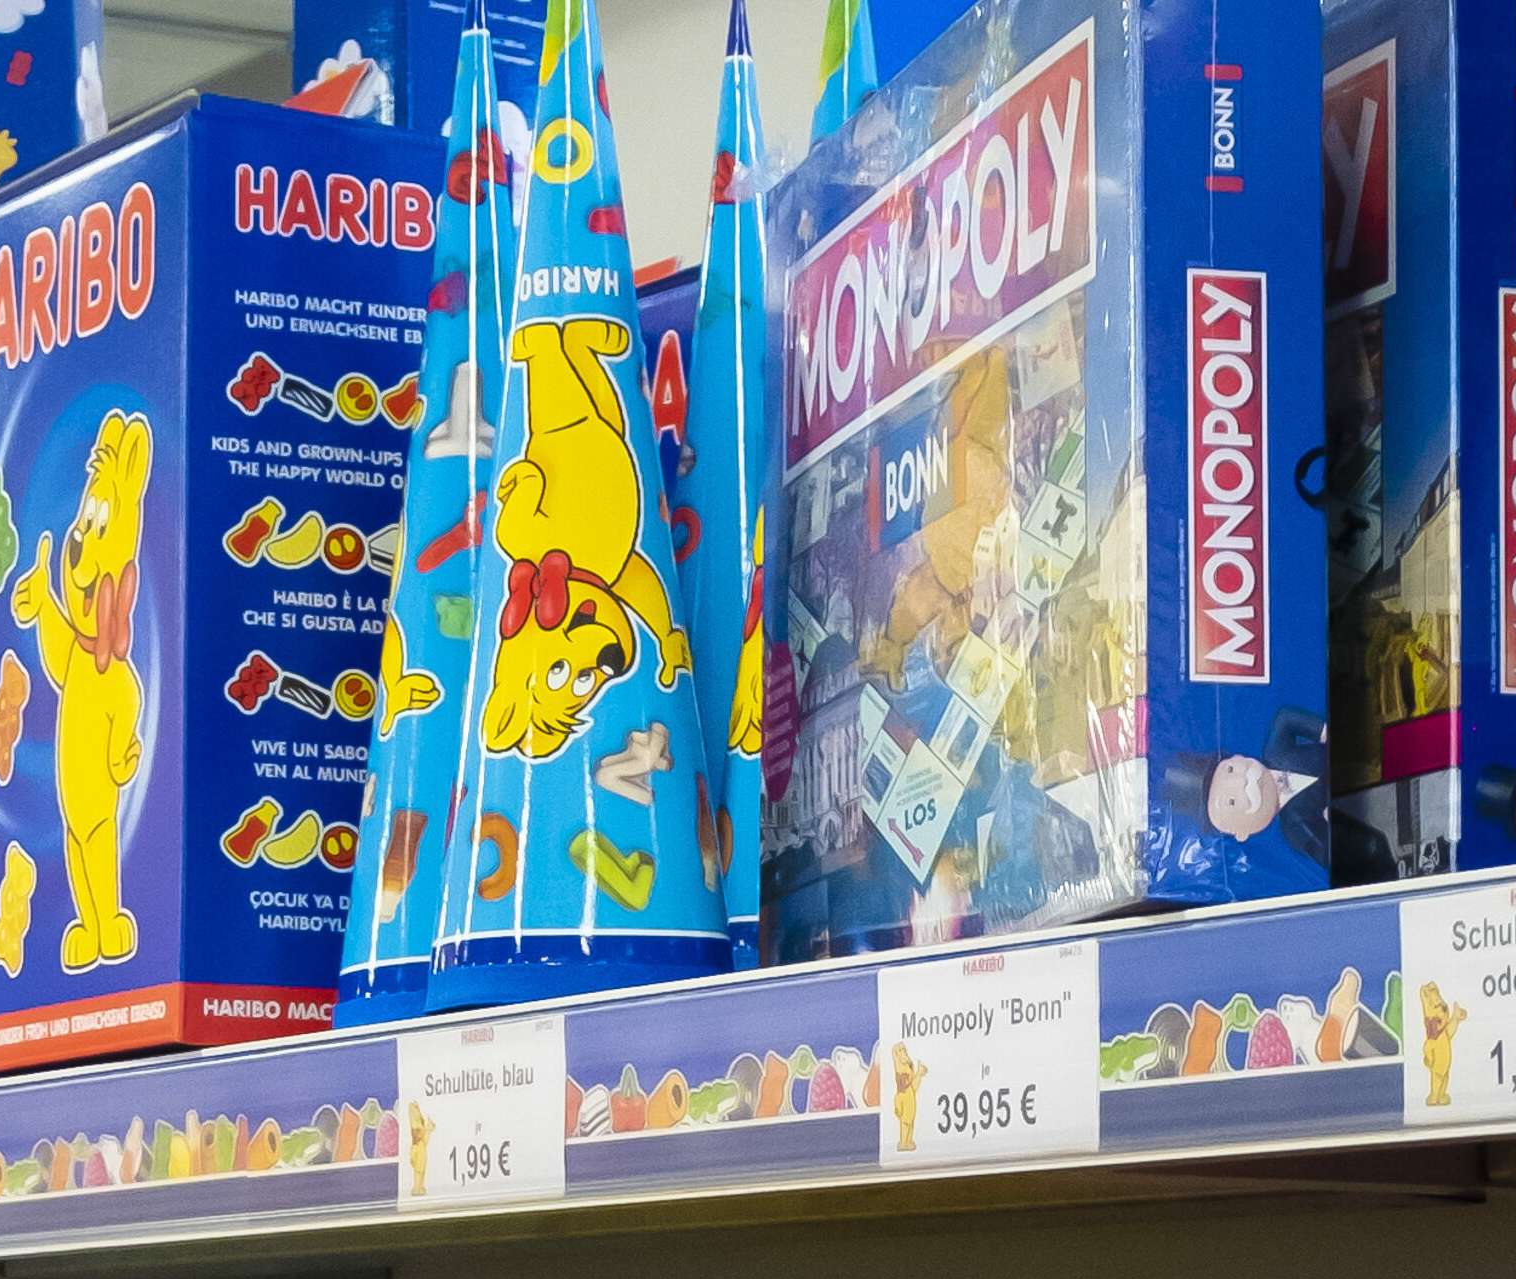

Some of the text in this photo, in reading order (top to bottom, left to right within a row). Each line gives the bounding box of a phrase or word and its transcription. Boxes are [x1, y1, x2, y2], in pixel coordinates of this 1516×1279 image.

[1214, 87, 1236, 170] BONN
[790, 77, 1082, 438] MONOPOLY
[519, 265, 620, 301] HARIBO
[235, 290, 427, 323] HARIBO MACHT KINDER
[245, 313, 284, 331] UND
[290, 317, 398, 343] ERWACHSENE
[211, 436, 403, 467] KIDS AND GROWN-UPS
[229, 460, 260, 477] THE
[266, 464, 321, 482] HAPPY
[326, 470, 385, 487] WORLD
[885, 426, 951, 522] BONN
[1201, 282, 1255, 667] MONOPOLY
[273, 588, 376, 611] HARIBO È LA
[243, 610, 276, 627] CHE
[281, 613, 296, 628] SI
[301, 615, 356, 633] GUSTA
[251, 739, 287, 757] VIVE
[292, 742, 318, 758] UN
[254, 763, 287, 779] VEN
[292, 765, 313, 780] AL
[902, 798, 938, 831] LOS
[249, 890, 309, 909] ÇOCUK
[313, 893, 334, 910] YA
[203, 998, 281, 1019] HARIBO
[901, 991, 1072, 1039] Monopoly "Bonn"
[425, 1063, 534, 1097] Schultüte, blau
[937, 1084, 1037, 1139] 39,95 €
[449, 1141, 511, 1187] 1,99 €
